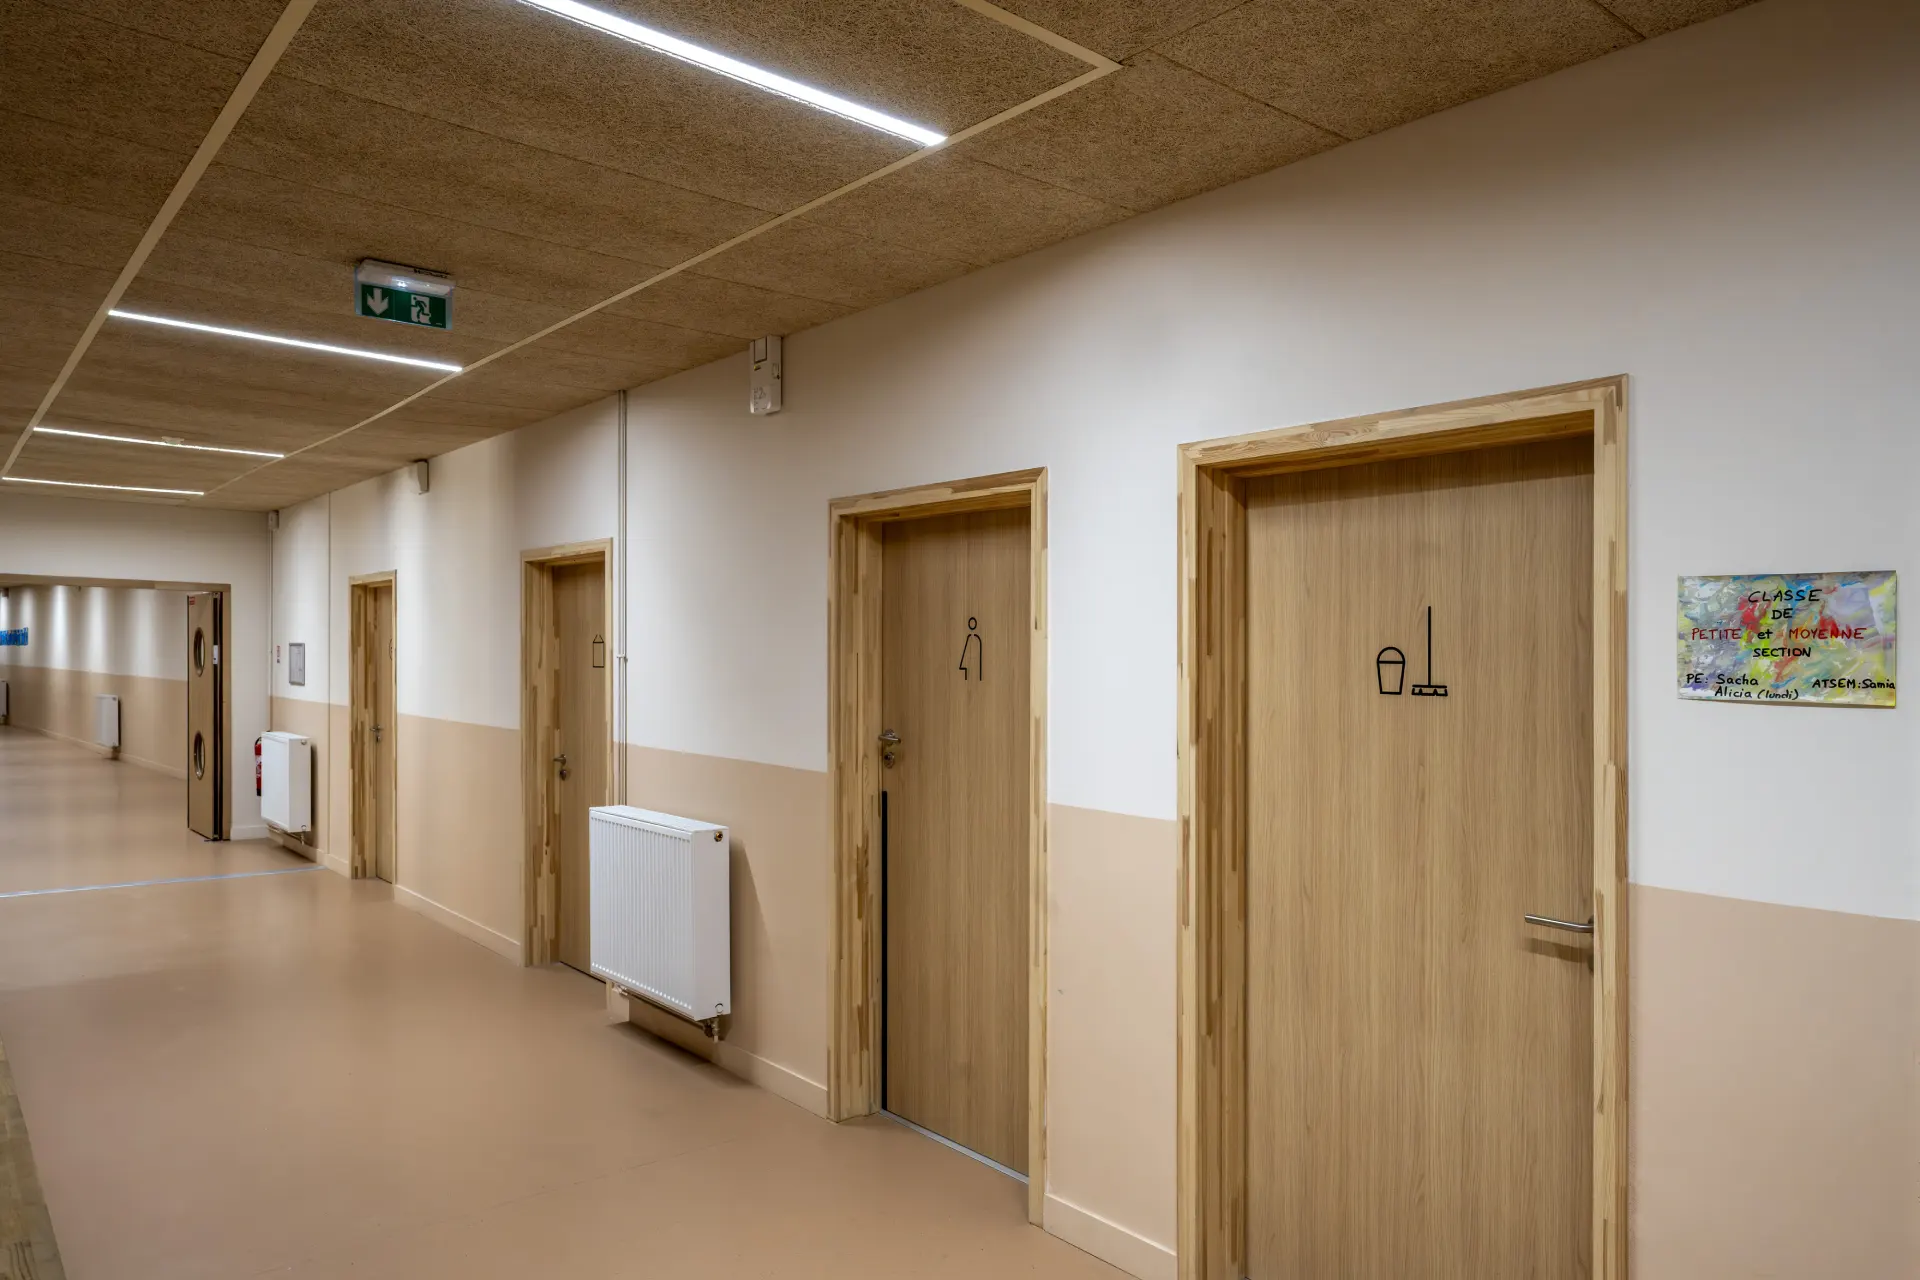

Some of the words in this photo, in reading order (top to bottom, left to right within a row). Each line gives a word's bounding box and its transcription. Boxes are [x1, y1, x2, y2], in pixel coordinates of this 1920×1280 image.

[1748, 589, 1822, 603] CLASSE
[1771, 608, 1794, 620] DE
[1691, 627, 1743, 641] PETITE
[1757, 629, 1773, 640] et
[1788, 627, 1867, 640] MOYENNE
[1752, 647, 1812, 658] SECTION
[1686, 673, 1708, 684] PE:
[1716, 673, 1759, 686] Sacha
[1714, 686, 1752, 698] Alicia
[1757, 688, 1799, 700] (lundi)
